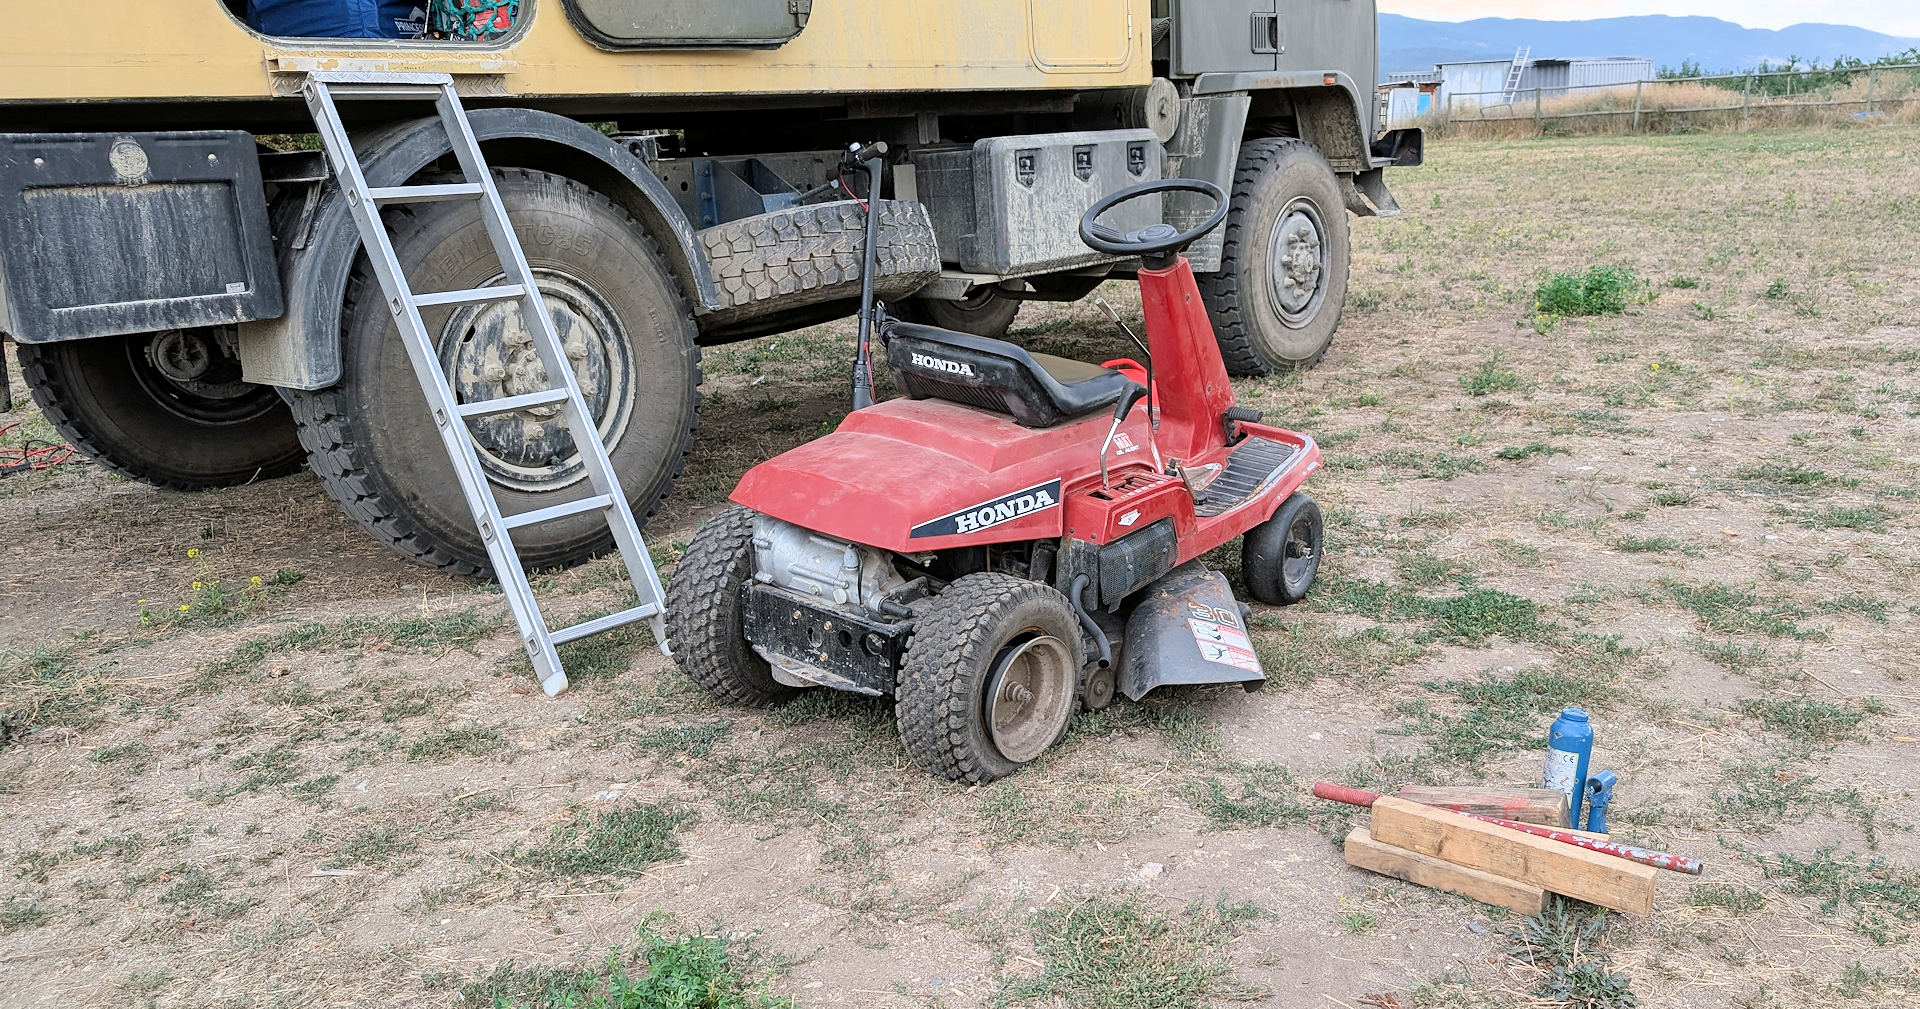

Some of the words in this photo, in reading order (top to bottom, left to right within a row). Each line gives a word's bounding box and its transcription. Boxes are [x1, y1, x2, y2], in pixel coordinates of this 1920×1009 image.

[911, 352, 974, 376] HONDA
[955, 489, 1055, 534] HONDA
[1188, 601, 1240, 629] 30
